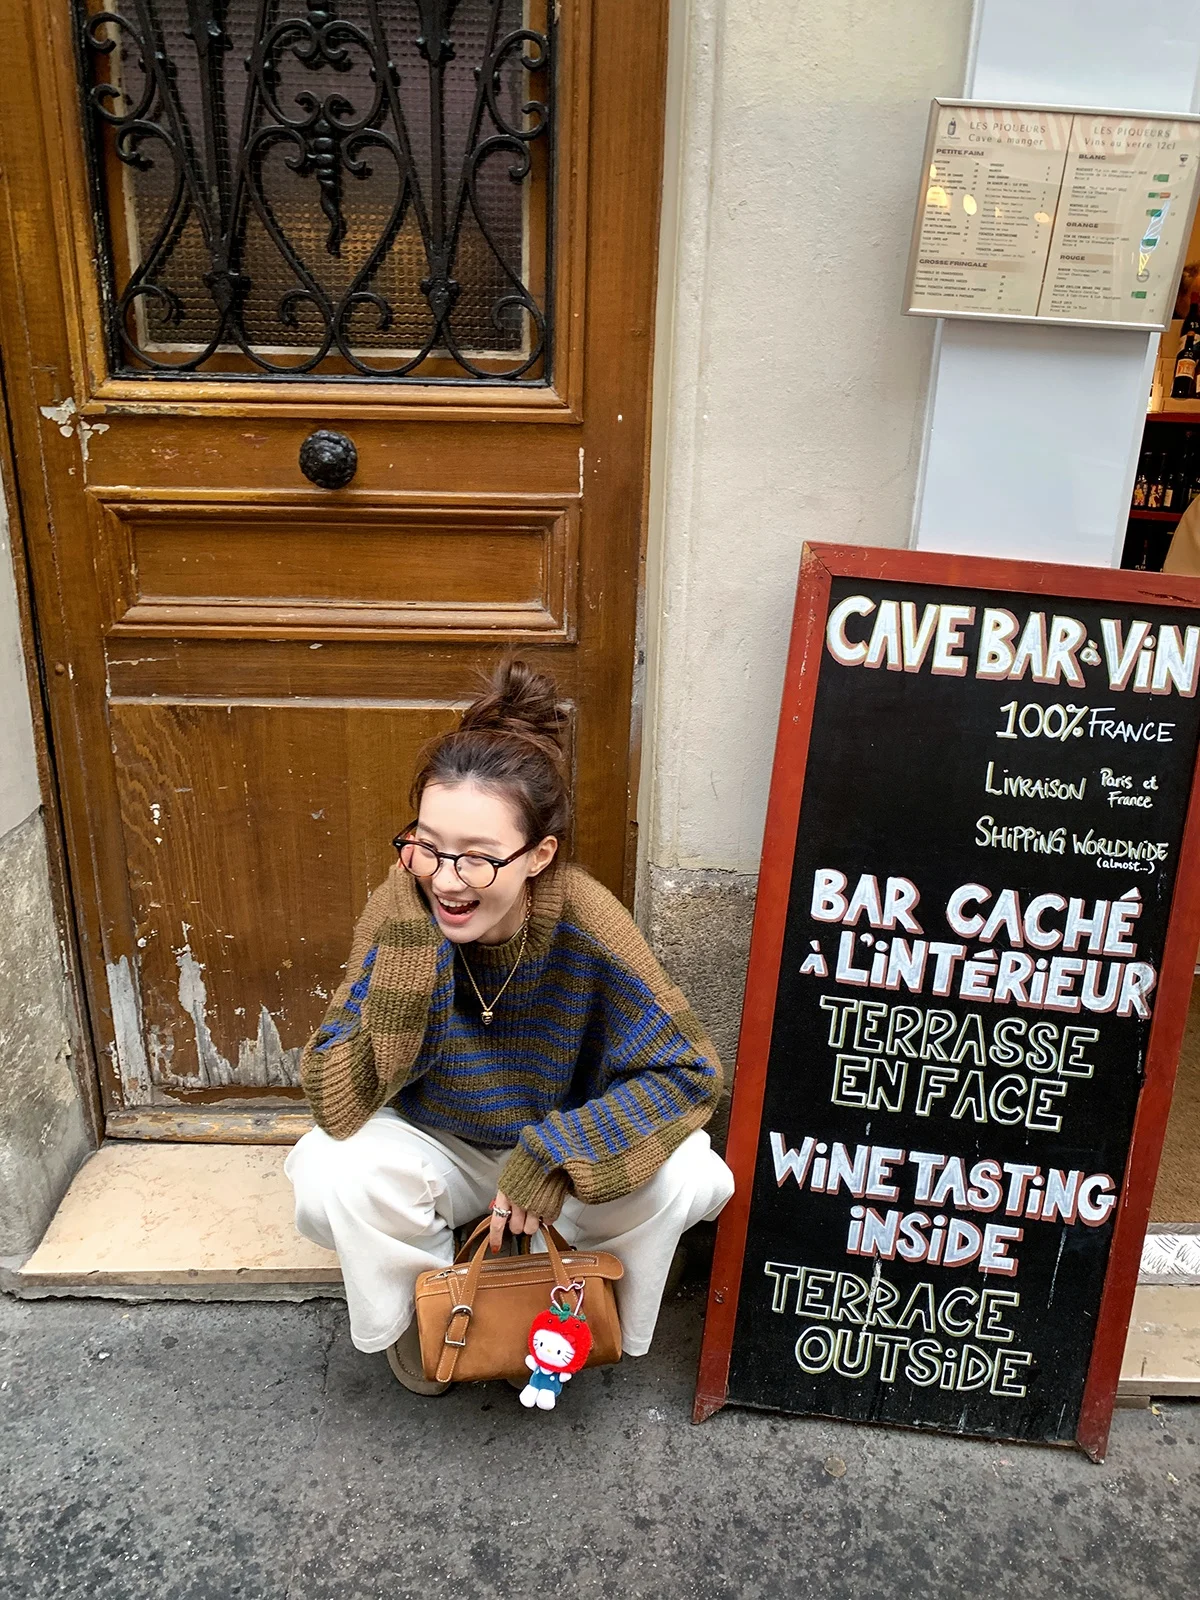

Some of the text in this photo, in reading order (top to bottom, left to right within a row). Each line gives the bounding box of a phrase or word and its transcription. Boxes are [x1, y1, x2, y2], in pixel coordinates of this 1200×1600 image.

[969, 121, 1046, 134] LES PIQUEURS
[1093, 126, 1172, 138] LES PIQUEURS
[968, 133, 993, 143] Cave
[1006, 136, 1044, 147] manger
[1084, 137, 1105, 146] Vins
[1110, 140, 1122, 148] au
[1126, 141, 1152, 149] verre
[936, 148, 984, 157] PETITE FAIM
[1078, 153, 1107, 161] BLANC
[1066, 221, 1099, 229] ORANGE
[919, 258, 988, 268] GROSSE FRINGALE
[826, 595, 975, 676] CAVE
[976, 607, 1087, 688] BAR
[1080, 642, 1101, 666] à
[996, 700, 1176, 743] 100% FRANCE
[1100, 767, 1133, 790] Paris
[1143, 773, 1158, 791] et
[1107, 791, 1153, 809] France
[811, 868, 1142, 957] BAR CACHÉ
[820, 995, 1099, 1077] TERRASSE
[831, 1054, 1068, 1132] EN FACE
[769, 1131, 1116, 1227] WiNE TASTiNG
[763, 1262, 1020, 1342] TERRACE
[794, 1325, 1032, 1397] OUTSiDE
